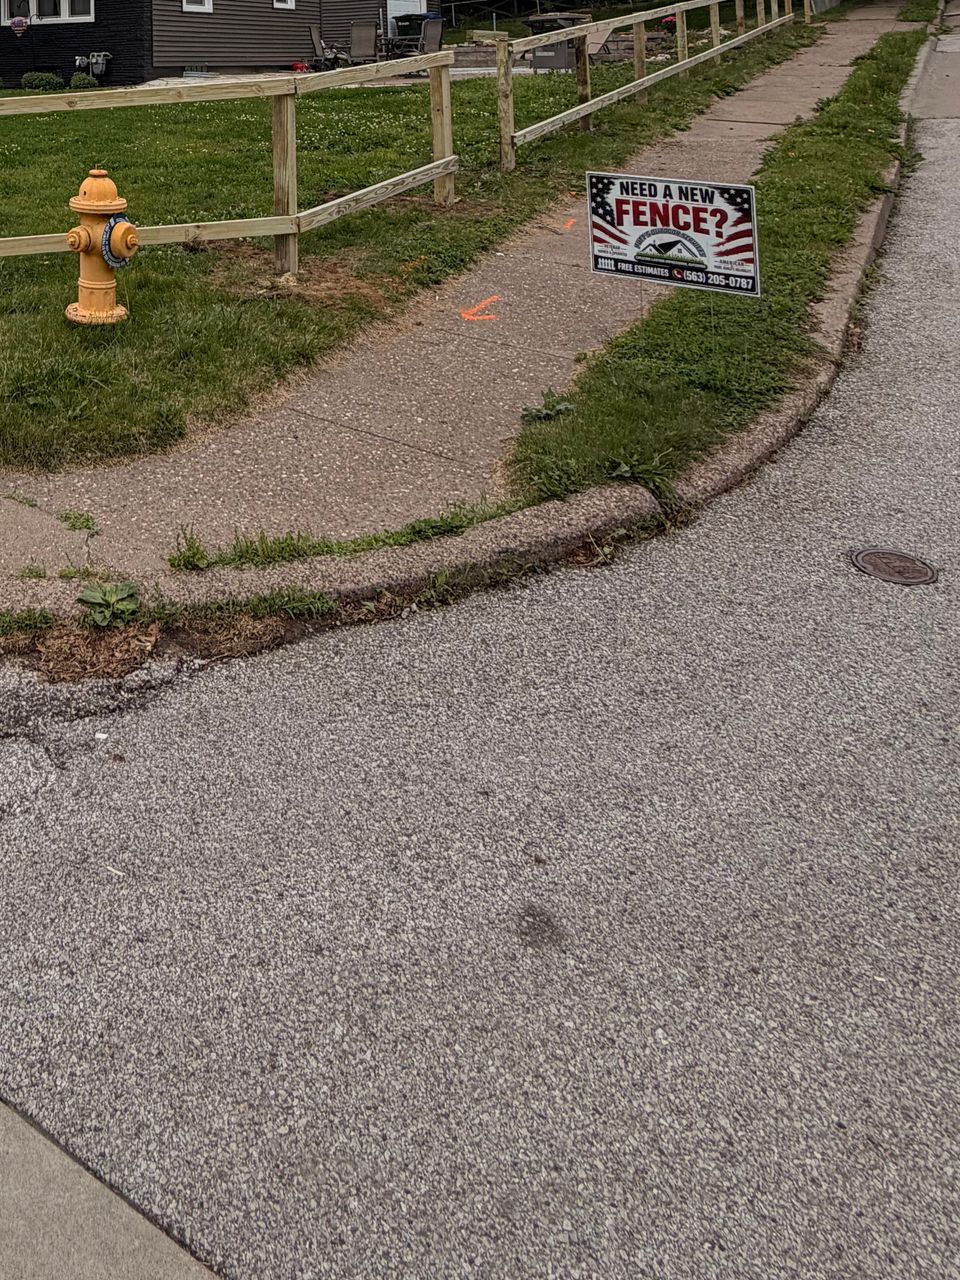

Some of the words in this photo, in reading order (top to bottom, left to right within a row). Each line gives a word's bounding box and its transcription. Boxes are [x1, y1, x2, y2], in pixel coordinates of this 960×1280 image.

[620, 181, 658, 197] NEED
[663, 184, 673, 200] A
[678, 186, 715, 204] NEW
[615, 198, 728, 239] FENCE?
[617, 263, 633, 272] FREE
[634, 264, 669, 277] ESTIMATES
[683, 270, 706, 283] (563)
[708, 274, 753, 289] 205-0787
